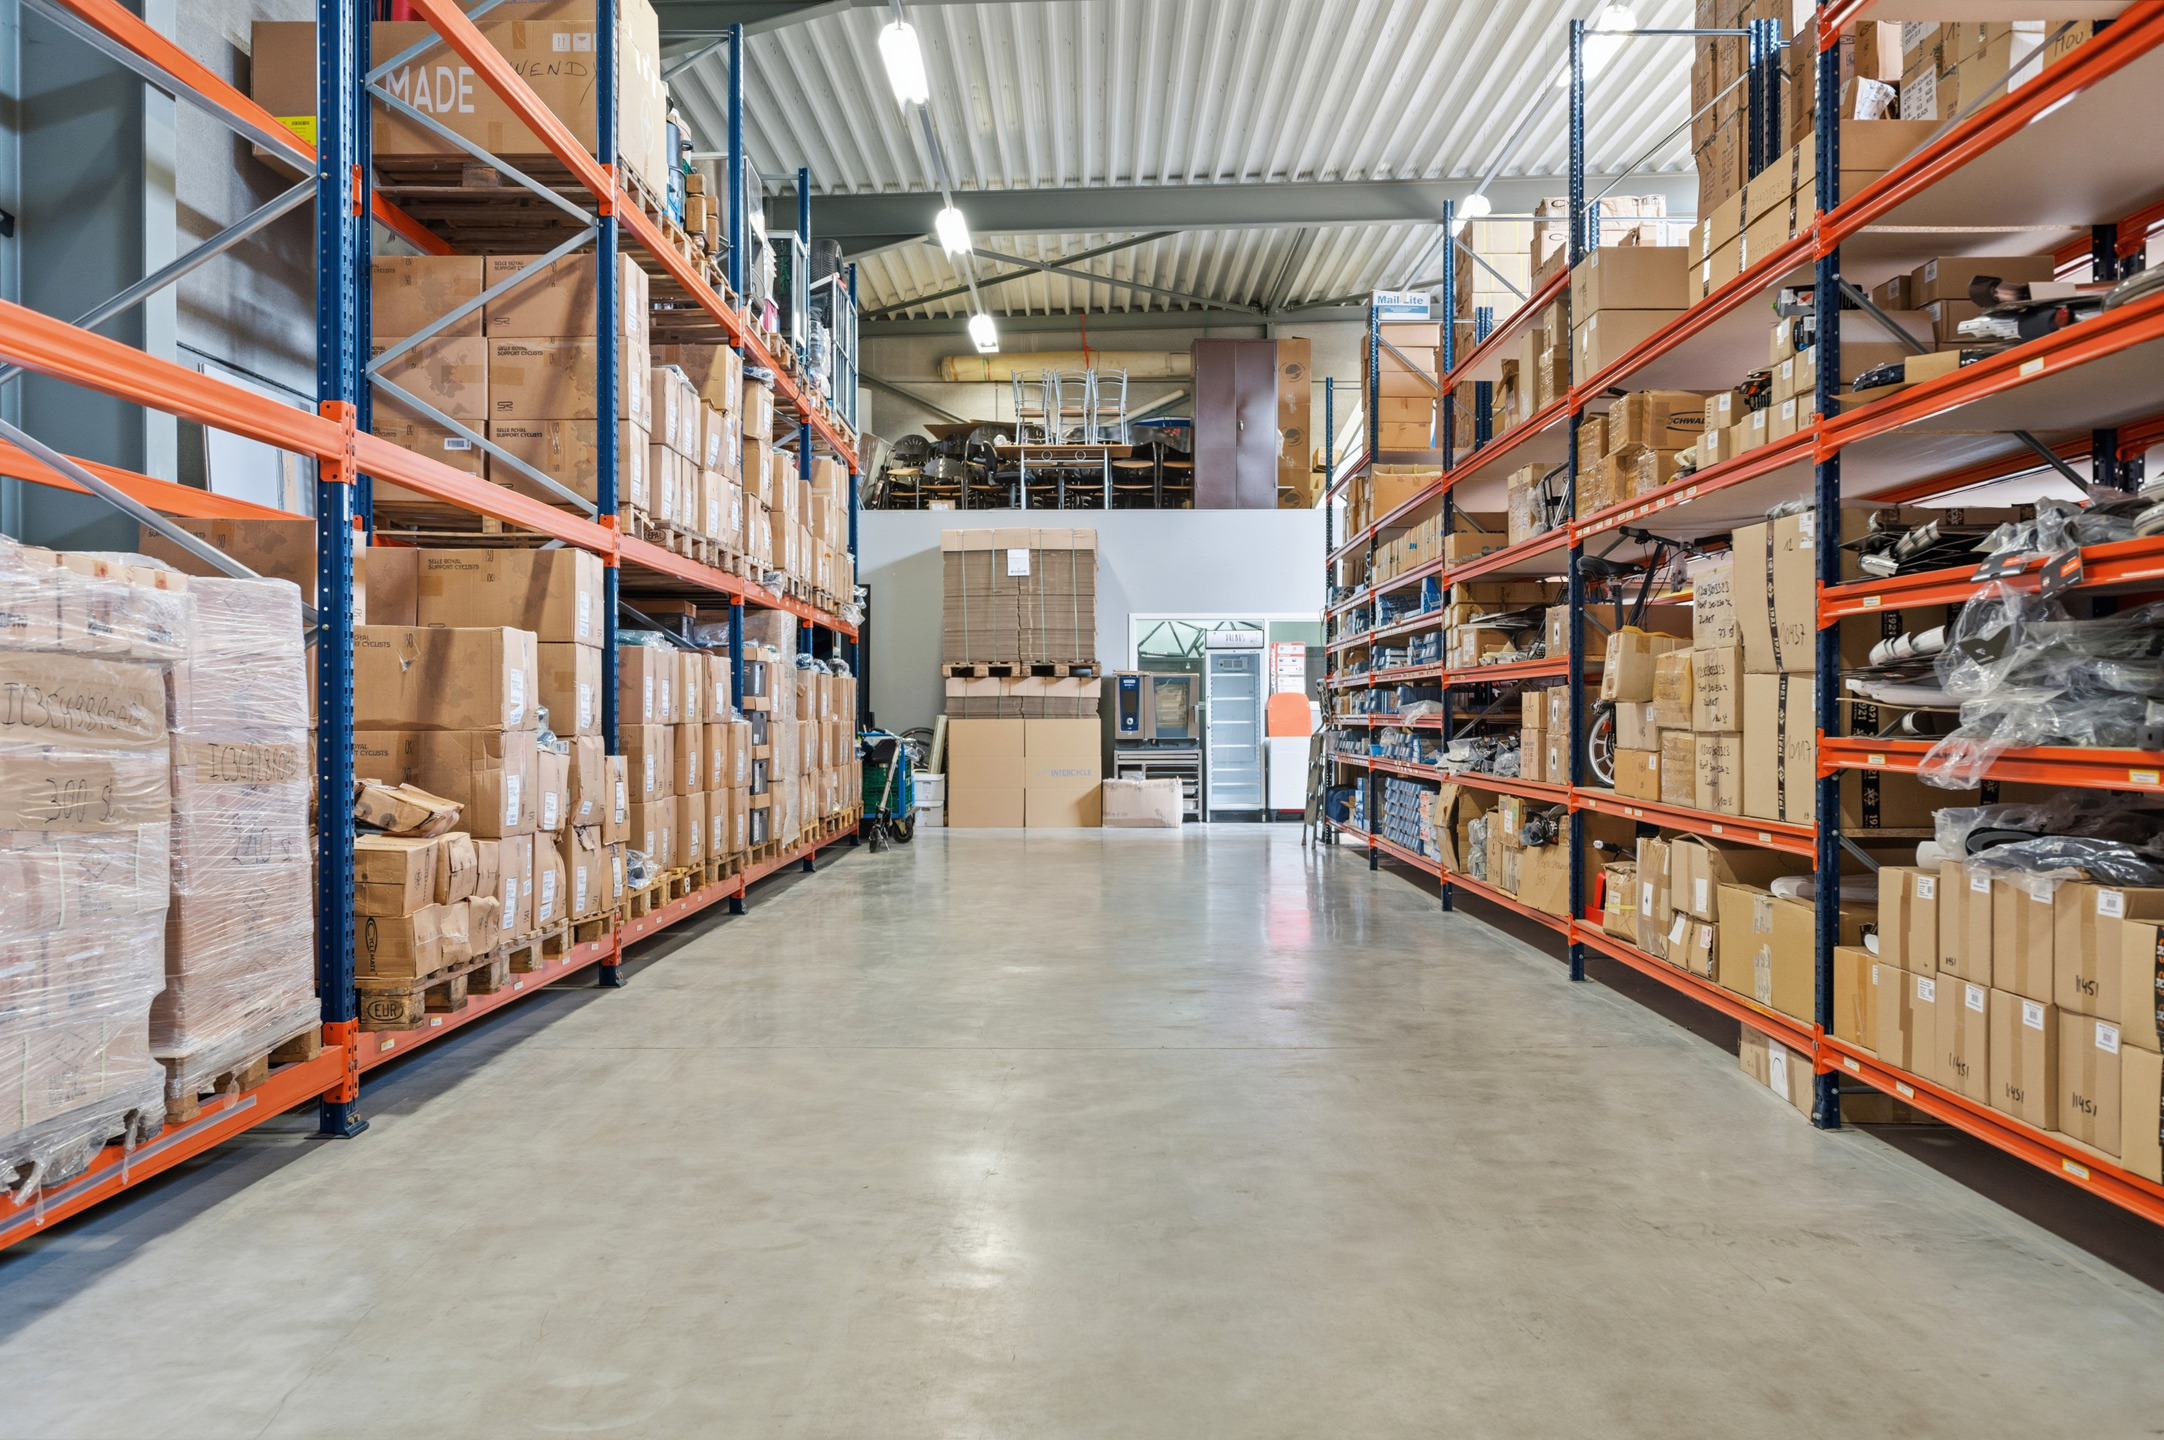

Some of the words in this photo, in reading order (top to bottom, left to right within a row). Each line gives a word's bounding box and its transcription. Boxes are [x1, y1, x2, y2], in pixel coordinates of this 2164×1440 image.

[385, 65, 475, 113] MADE
[1377, 295, 1400, 304] Mail
[1888, 613, 1897, 636] 1921
[1051, 768, 1092, 777] INTERCYCLE
[45, 779, 88, 823] 300
[364, 916, 379, 974] CYCLEMATE
[2075, 974, 2099, 998] 11451
[374, 1001, 398, 1018] EUR
[1948, 1052, 1970, 1080] 11451
[2073, 1091, 2097, 1117] 11451
